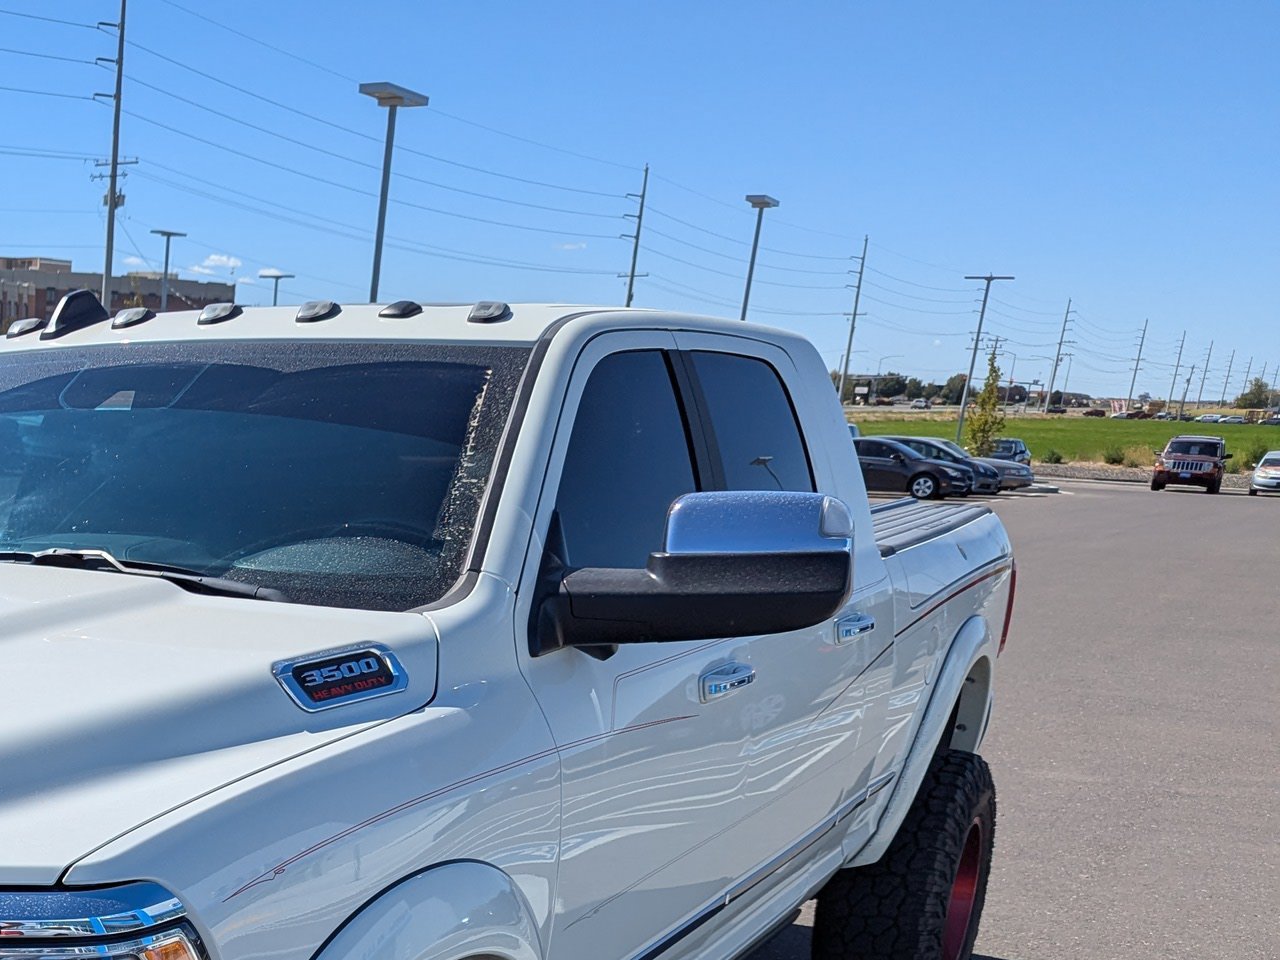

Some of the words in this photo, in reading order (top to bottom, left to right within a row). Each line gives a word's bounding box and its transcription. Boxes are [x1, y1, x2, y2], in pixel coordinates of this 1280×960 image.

[301, 657, 379, 686] 3500
[312, 683, 354, 700] HEAVY
[354, 676, 386, 690] DUTY
